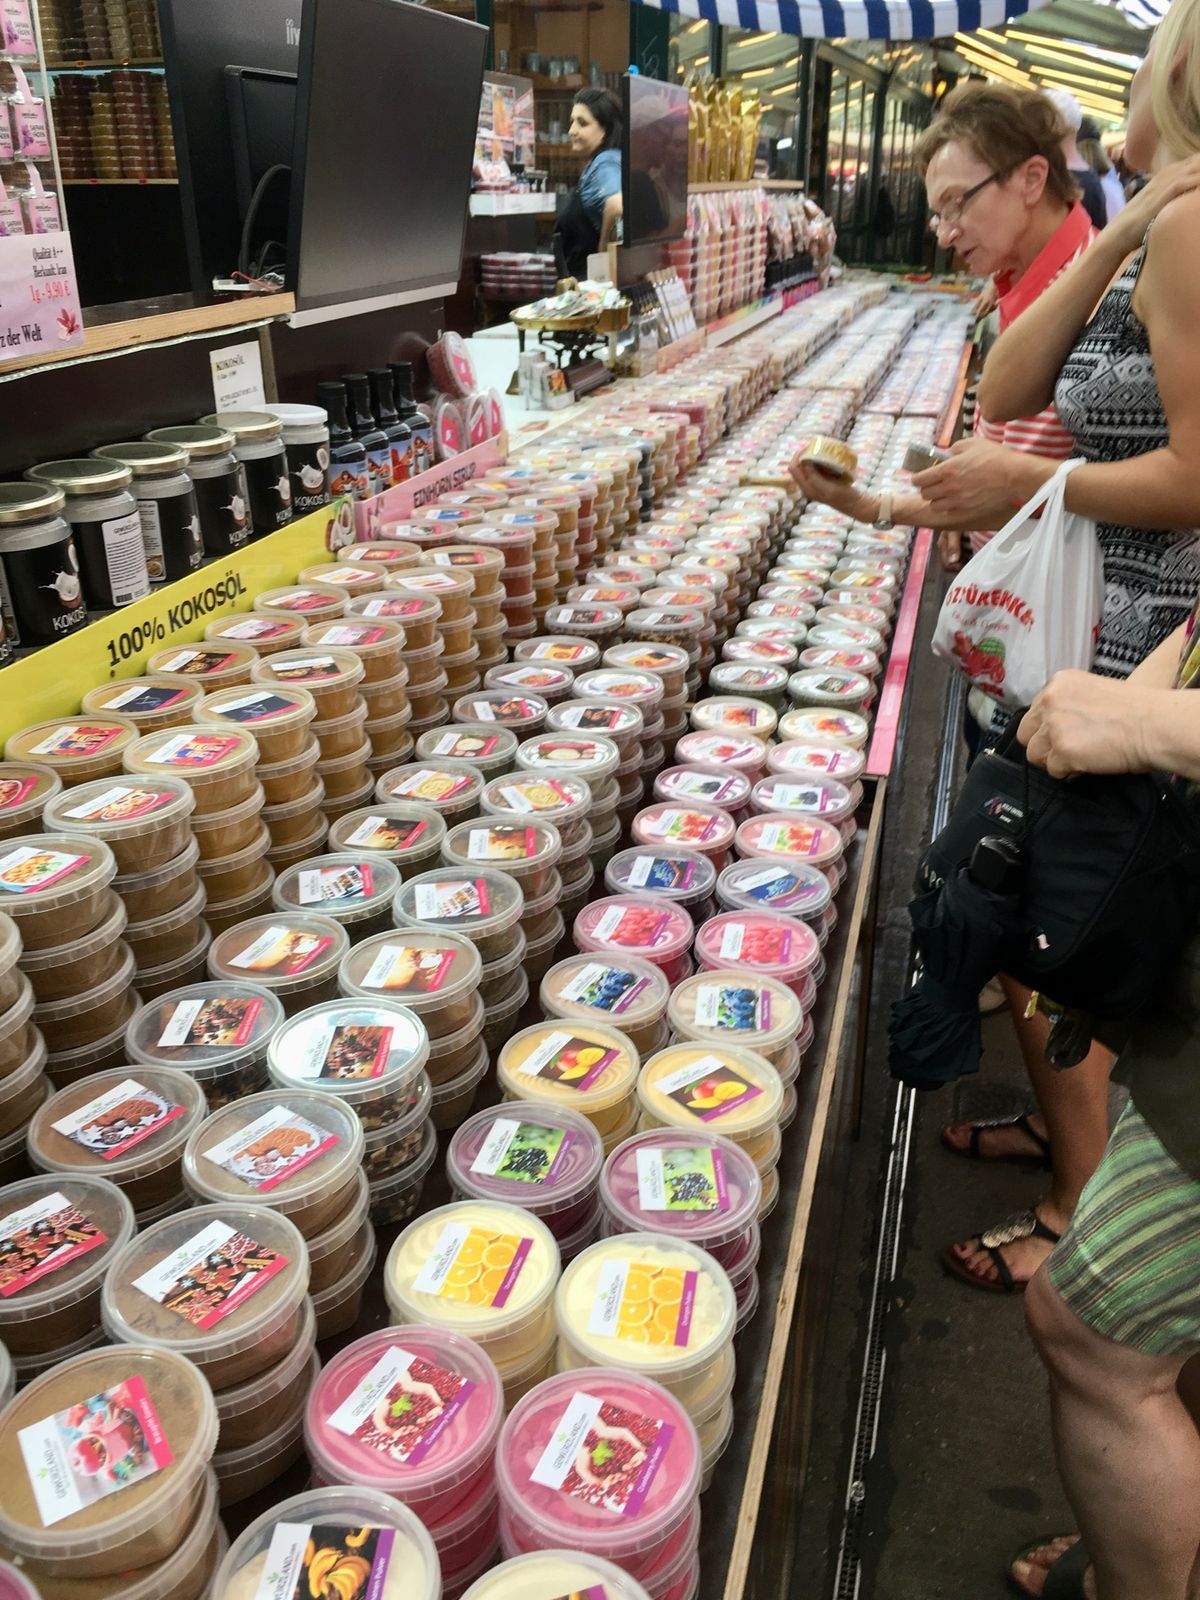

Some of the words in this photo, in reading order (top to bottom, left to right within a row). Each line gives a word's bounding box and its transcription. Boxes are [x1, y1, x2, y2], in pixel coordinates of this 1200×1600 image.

[6, 328, 21, 347] der
[21, 323, 43, 343] Welt
[412, 473, 452, 509] EINHORN
[107, 617, 167, 667] 100%
[167, 570, 247, 634] KOKOSÖL
[372, 1556, 388, 1580] Pulver
